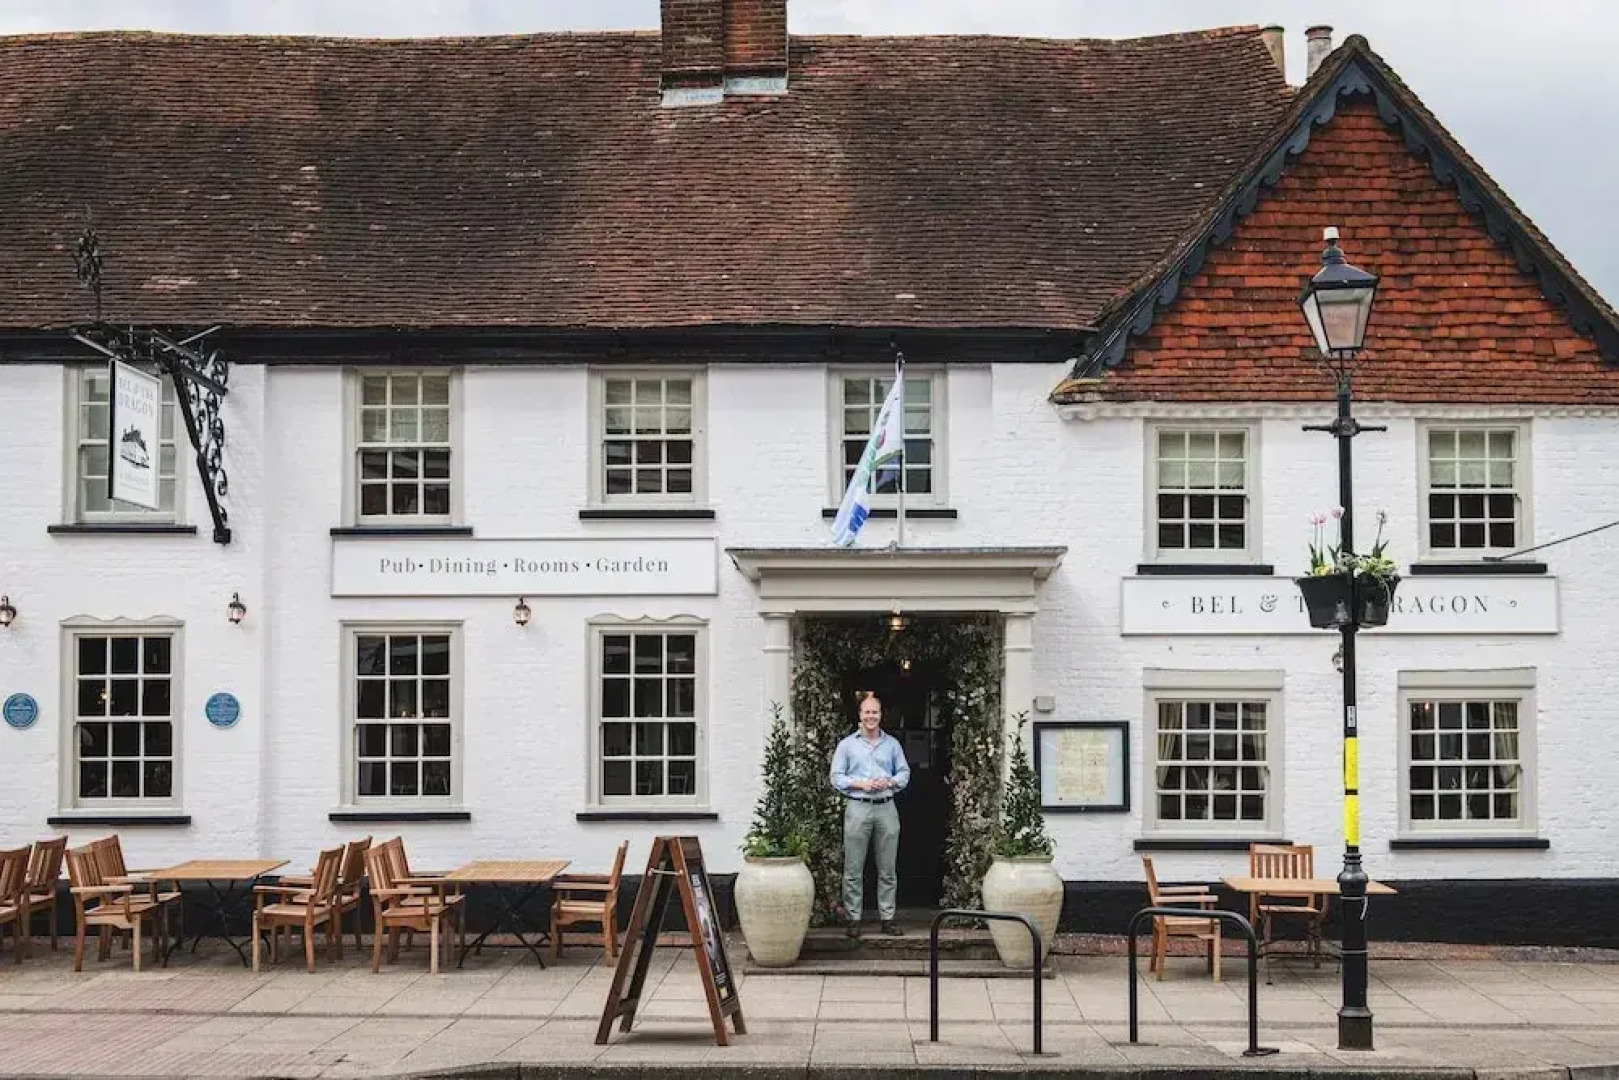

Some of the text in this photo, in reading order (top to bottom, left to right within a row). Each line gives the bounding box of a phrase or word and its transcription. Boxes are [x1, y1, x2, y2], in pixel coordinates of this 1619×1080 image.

[117, 392, 154, 417] DRAGON
[380, 556, 669, 575] Pub Dining Rooms Garden
[1192, 595, 1242, 614] BEL
[1260, 593, 1278, 613] &
[1391, 595, 1490, 614] RAGON
